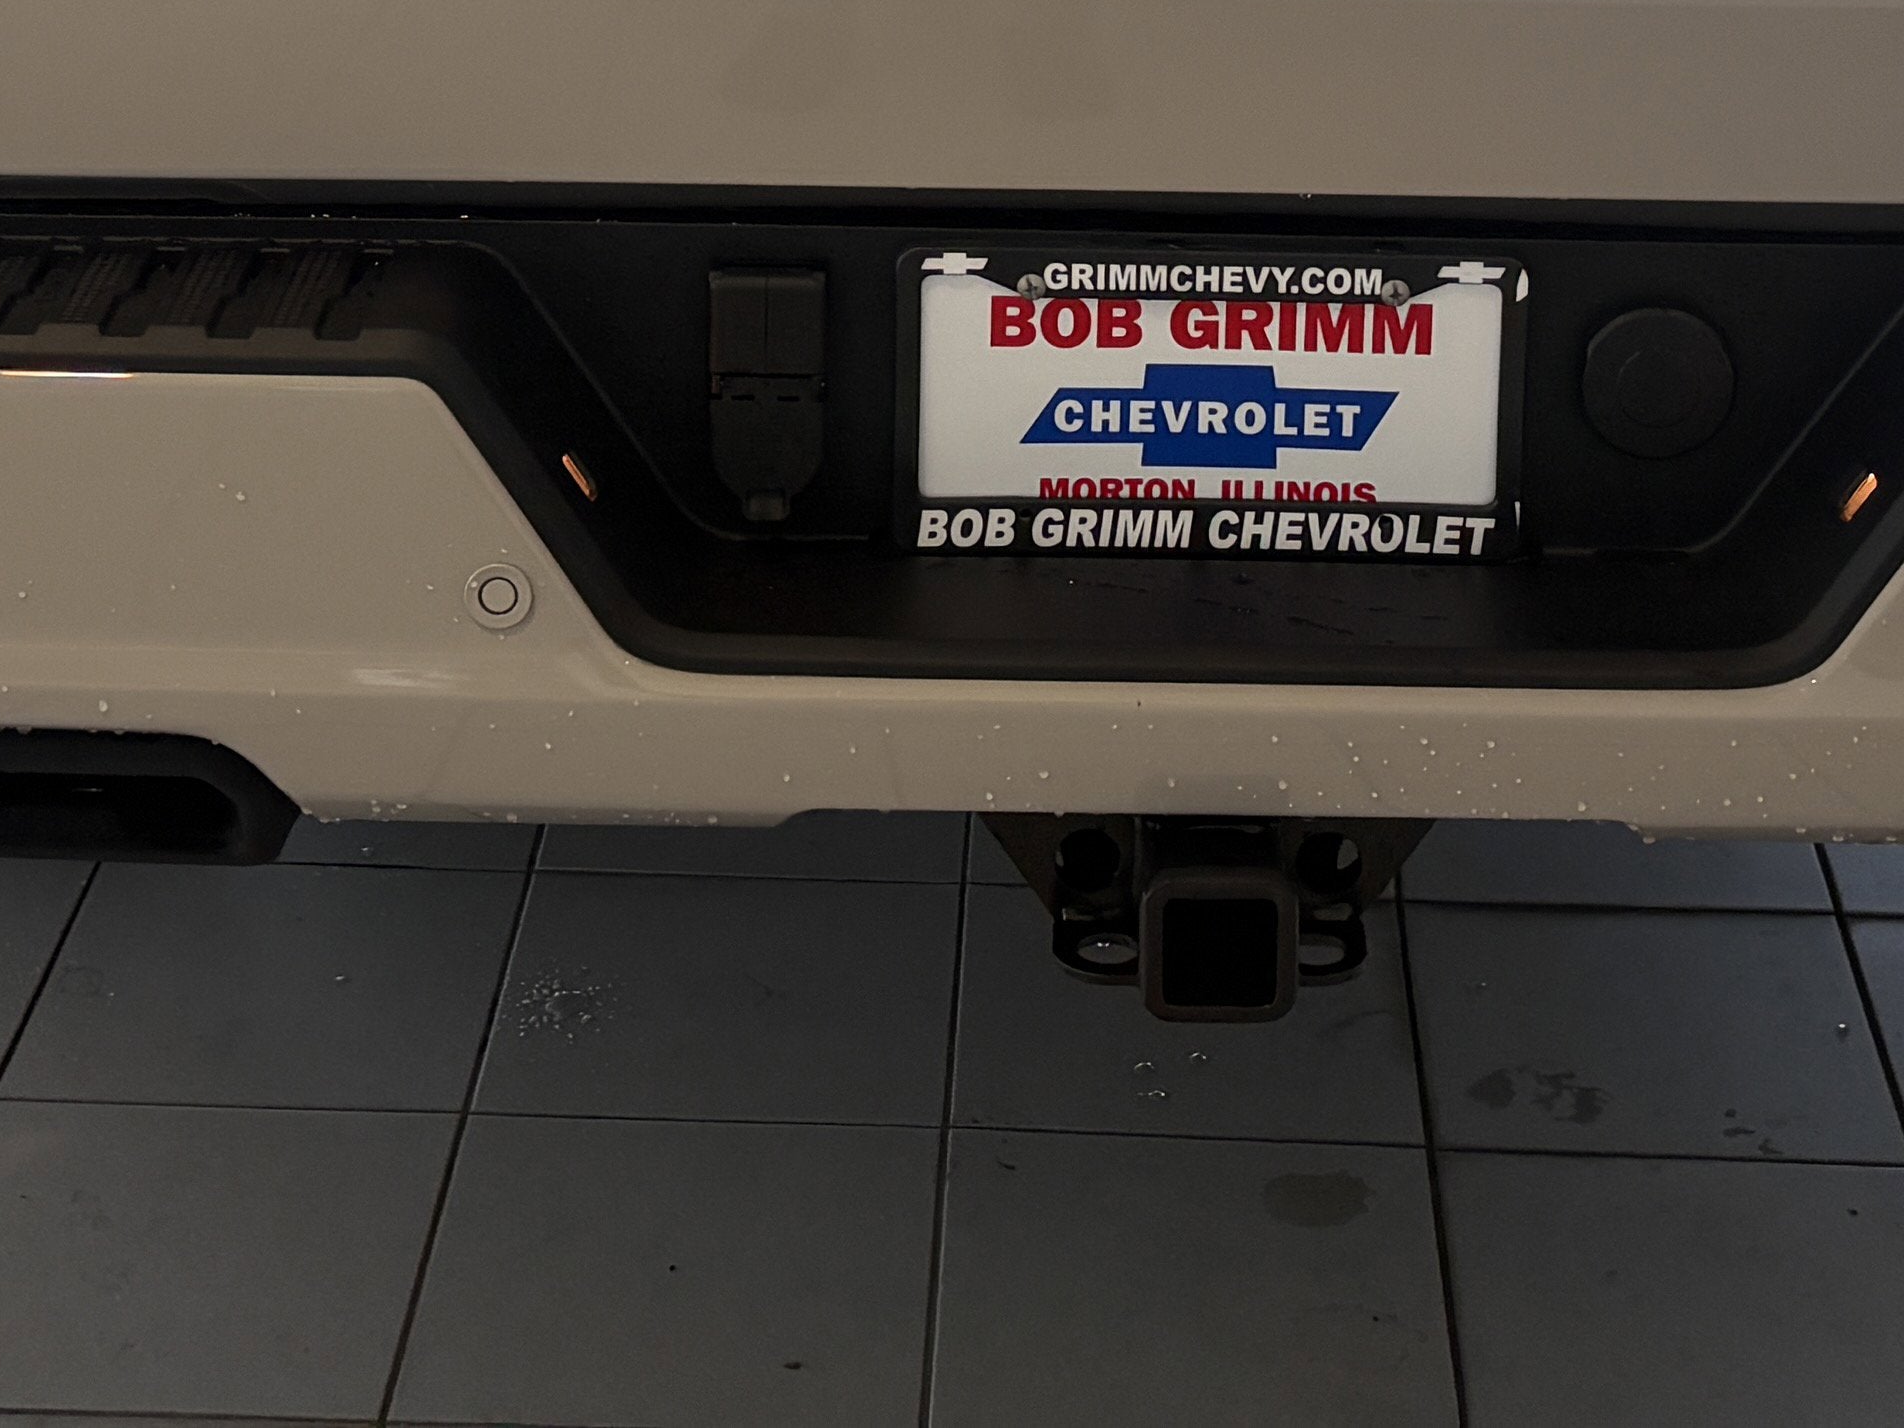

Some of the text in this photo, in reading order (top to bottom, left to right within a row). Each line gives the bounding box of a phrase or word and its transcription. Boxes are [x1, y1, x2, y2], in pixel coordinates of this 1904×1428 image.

[1042, 261, 1383, 298] GRIMMCHEVY.COM
[989, 295, 1434, 356] BOB GRIMM
[1053, 398, 1362, 439] CHEVROLET
[1039, 477, 1196, 501] MORTON
[916, 508, 1496, 556] BOB GRIMM CHEVROLET
